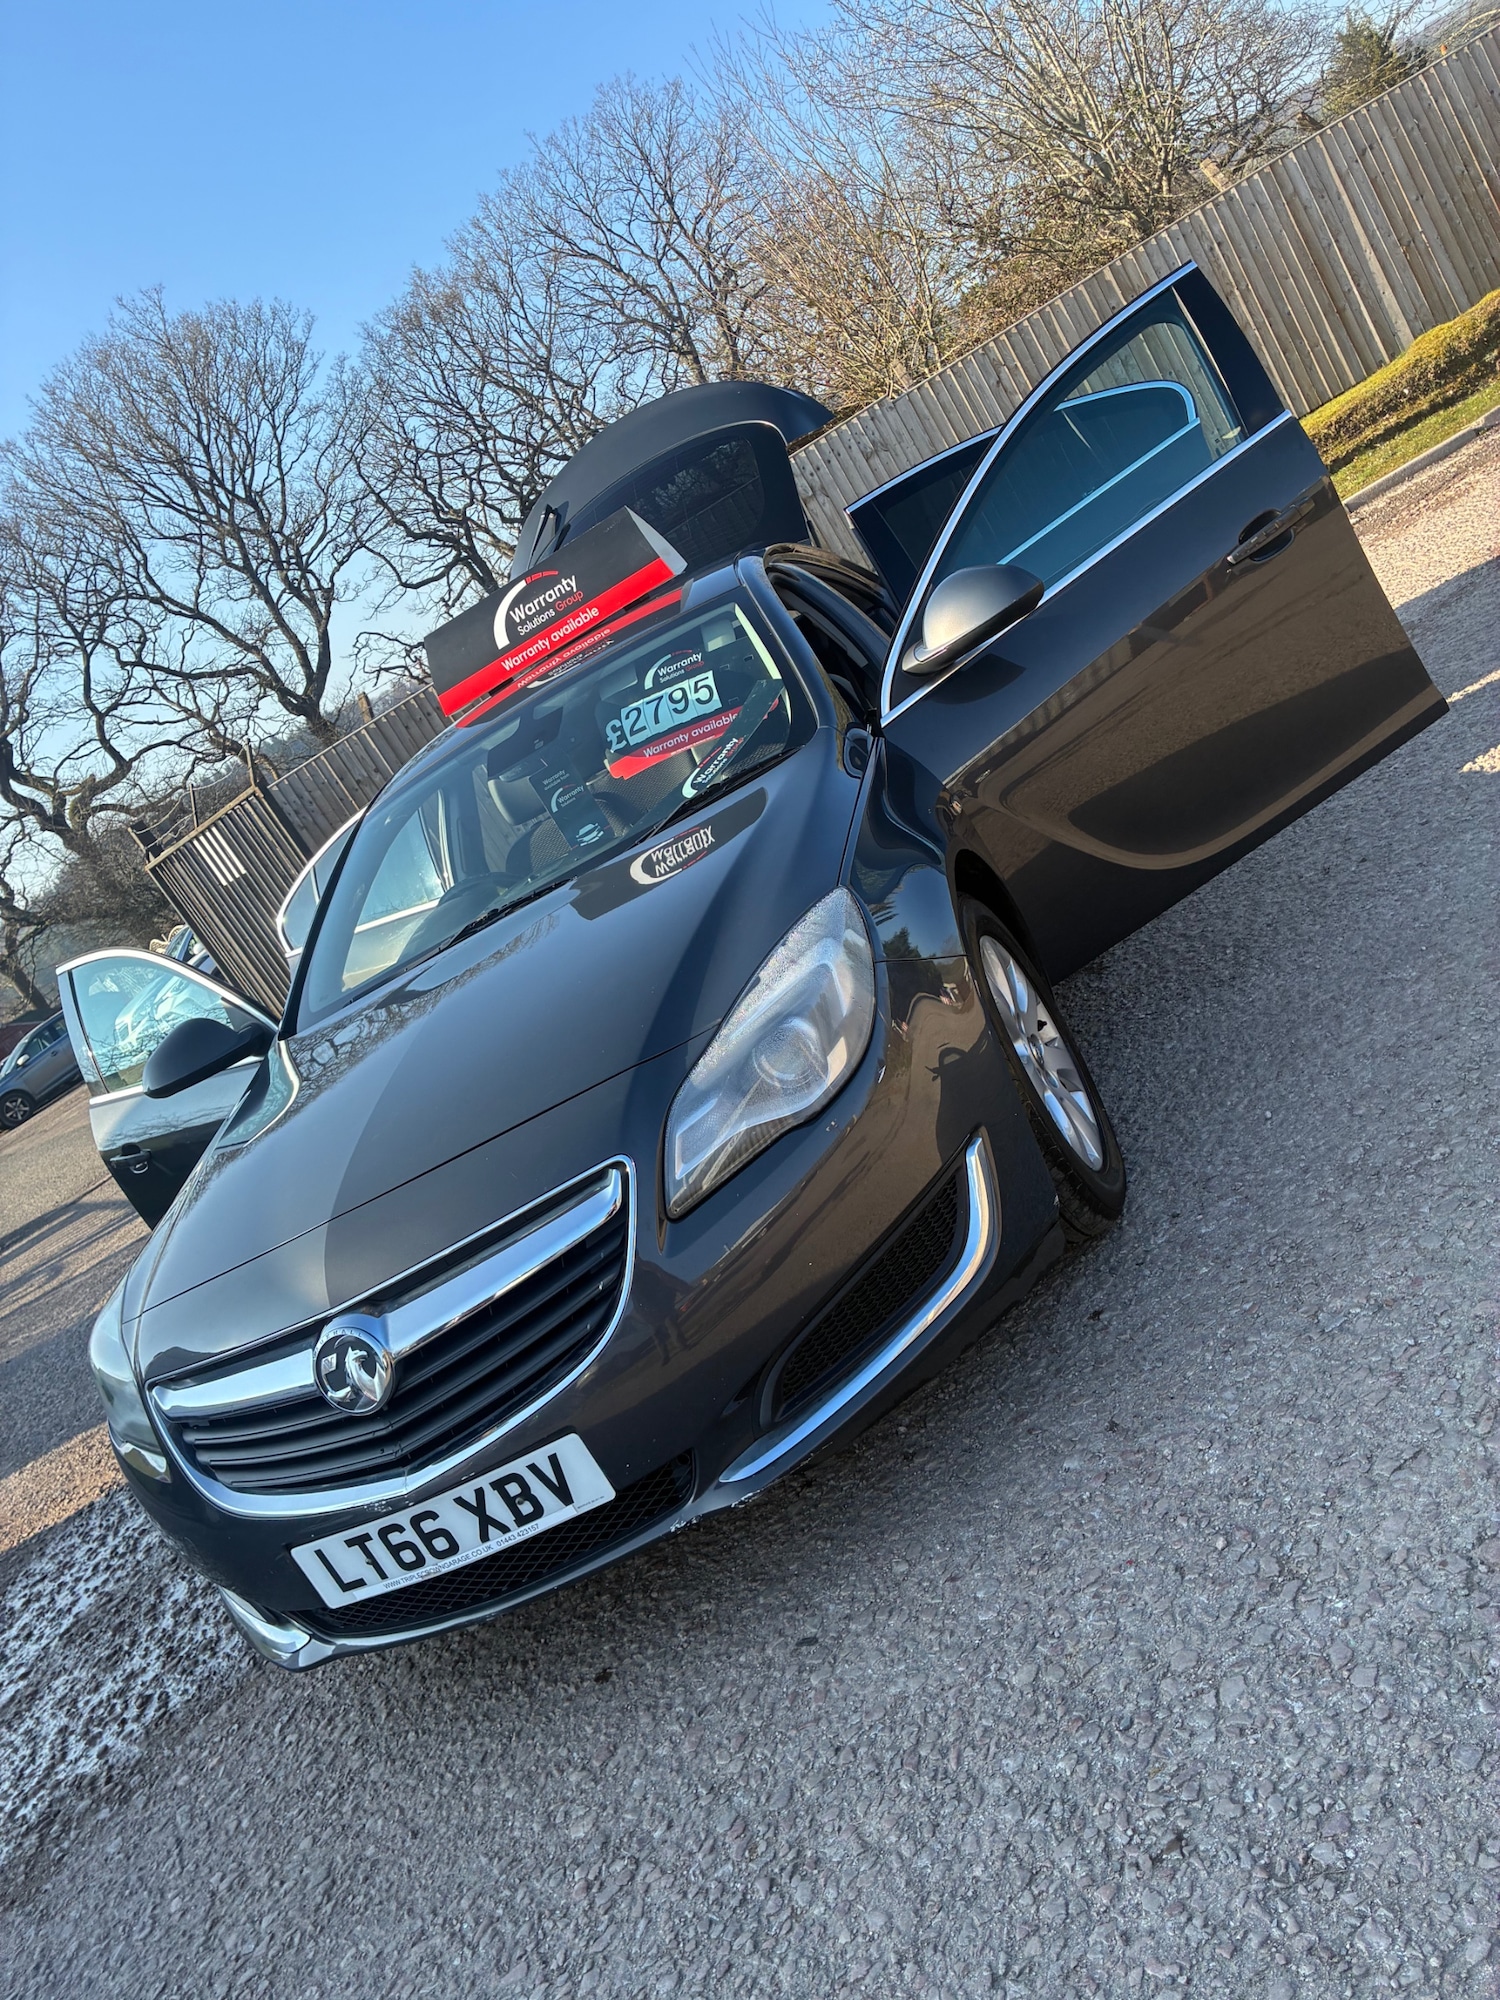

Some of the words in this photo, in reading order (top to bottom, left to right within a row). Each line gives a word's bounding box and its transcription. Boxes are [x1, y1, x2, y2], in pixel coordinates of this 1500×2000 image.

[509, 575, 578, 623] Warranty
[517, 609, 555, 636] Solutions
[555, 590, 584, 612] Group
[501, 637, 551, 671] Warranty
[550, 606, 600, 642] available
[657, 652, 702, 677] Warranty
[659, 669, 685, 683] Solutions
[605, 676, 714, 753] £2795
[643, 731, 690, 758] Warranty
[693, 736, 739, 785] Warranty
[557, 785, 585, 804] Warranty
[314, 1510, 460, 1592] LT66
[452, 1452, 575, 1544] XBV
